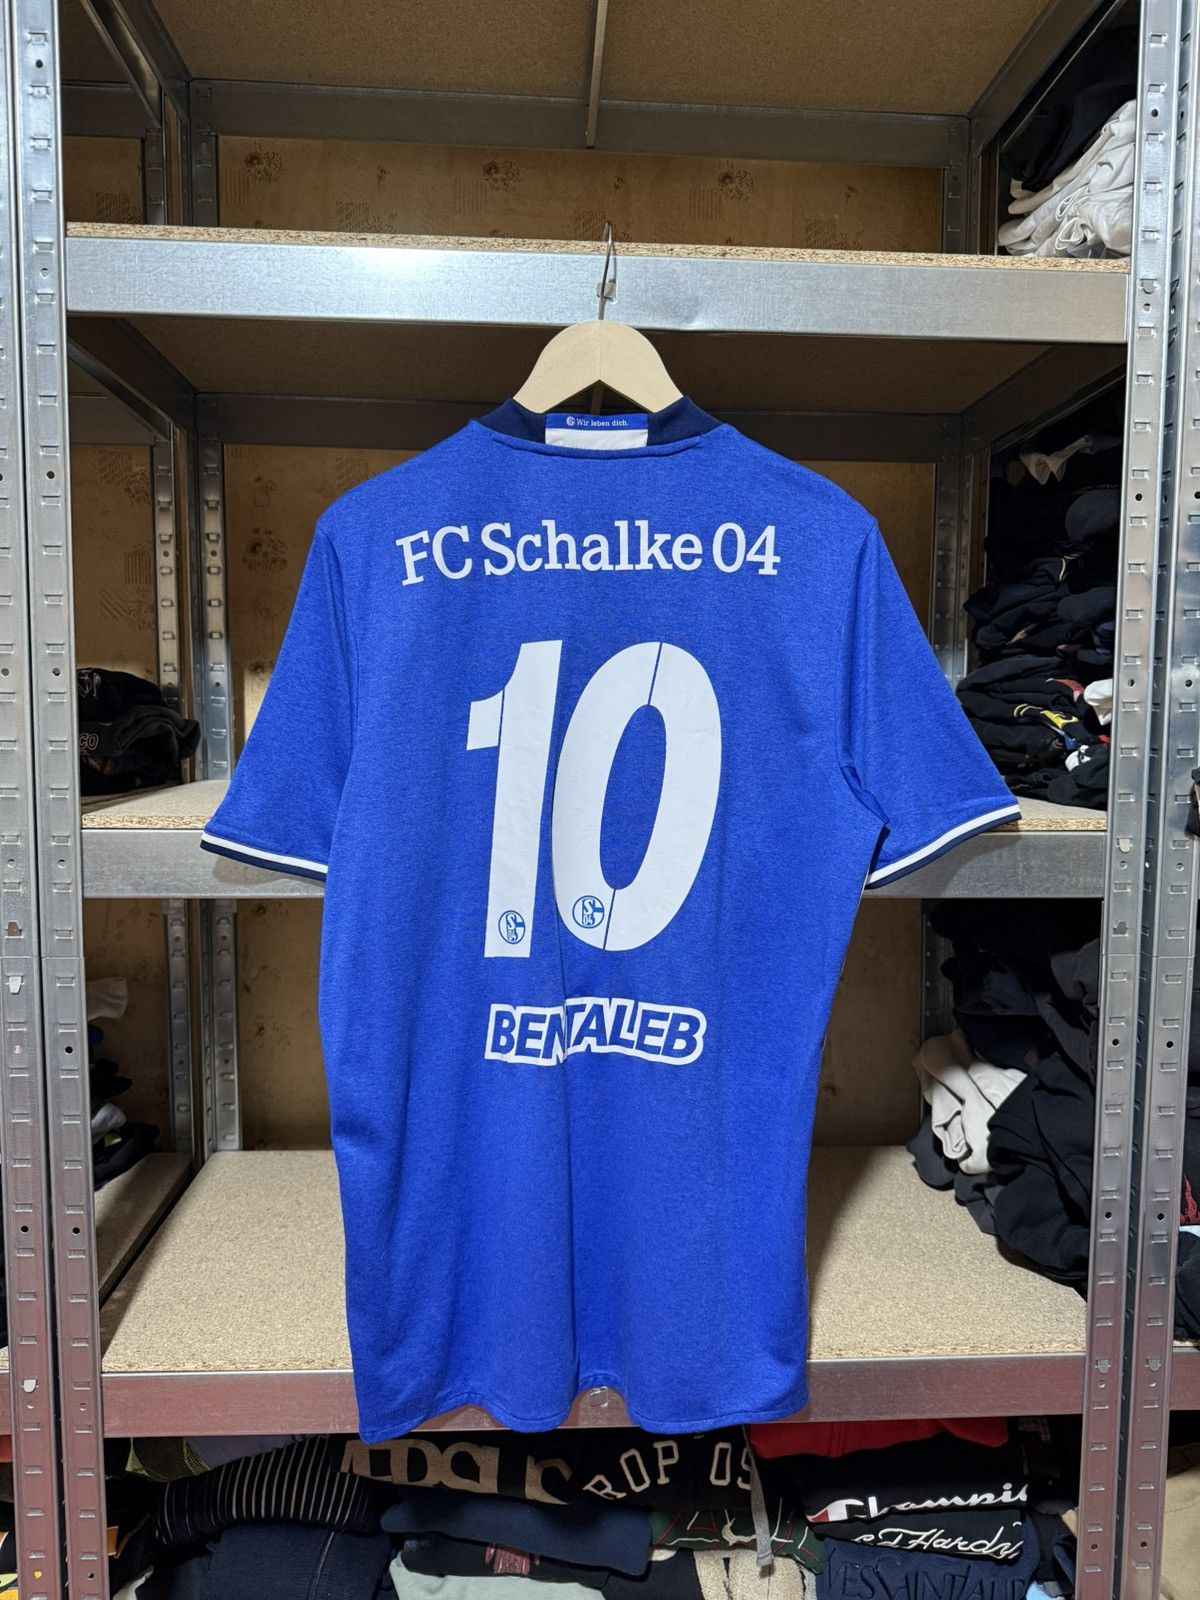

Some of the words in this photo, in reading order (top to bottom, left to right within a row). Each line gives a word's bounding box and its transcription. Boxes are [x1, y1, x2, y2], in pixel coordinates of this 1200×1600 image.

[576, 418, 590, 426] Wir
[611, 419, 629, 427] dich.
[396, 525, 472, 587] FC
[480, 519, 703, 576] Schalke
[711, 522, 781, 576] 04
[466, 639, 722, 958] 10
[484, 996, 708, 1066] BENTALEB
